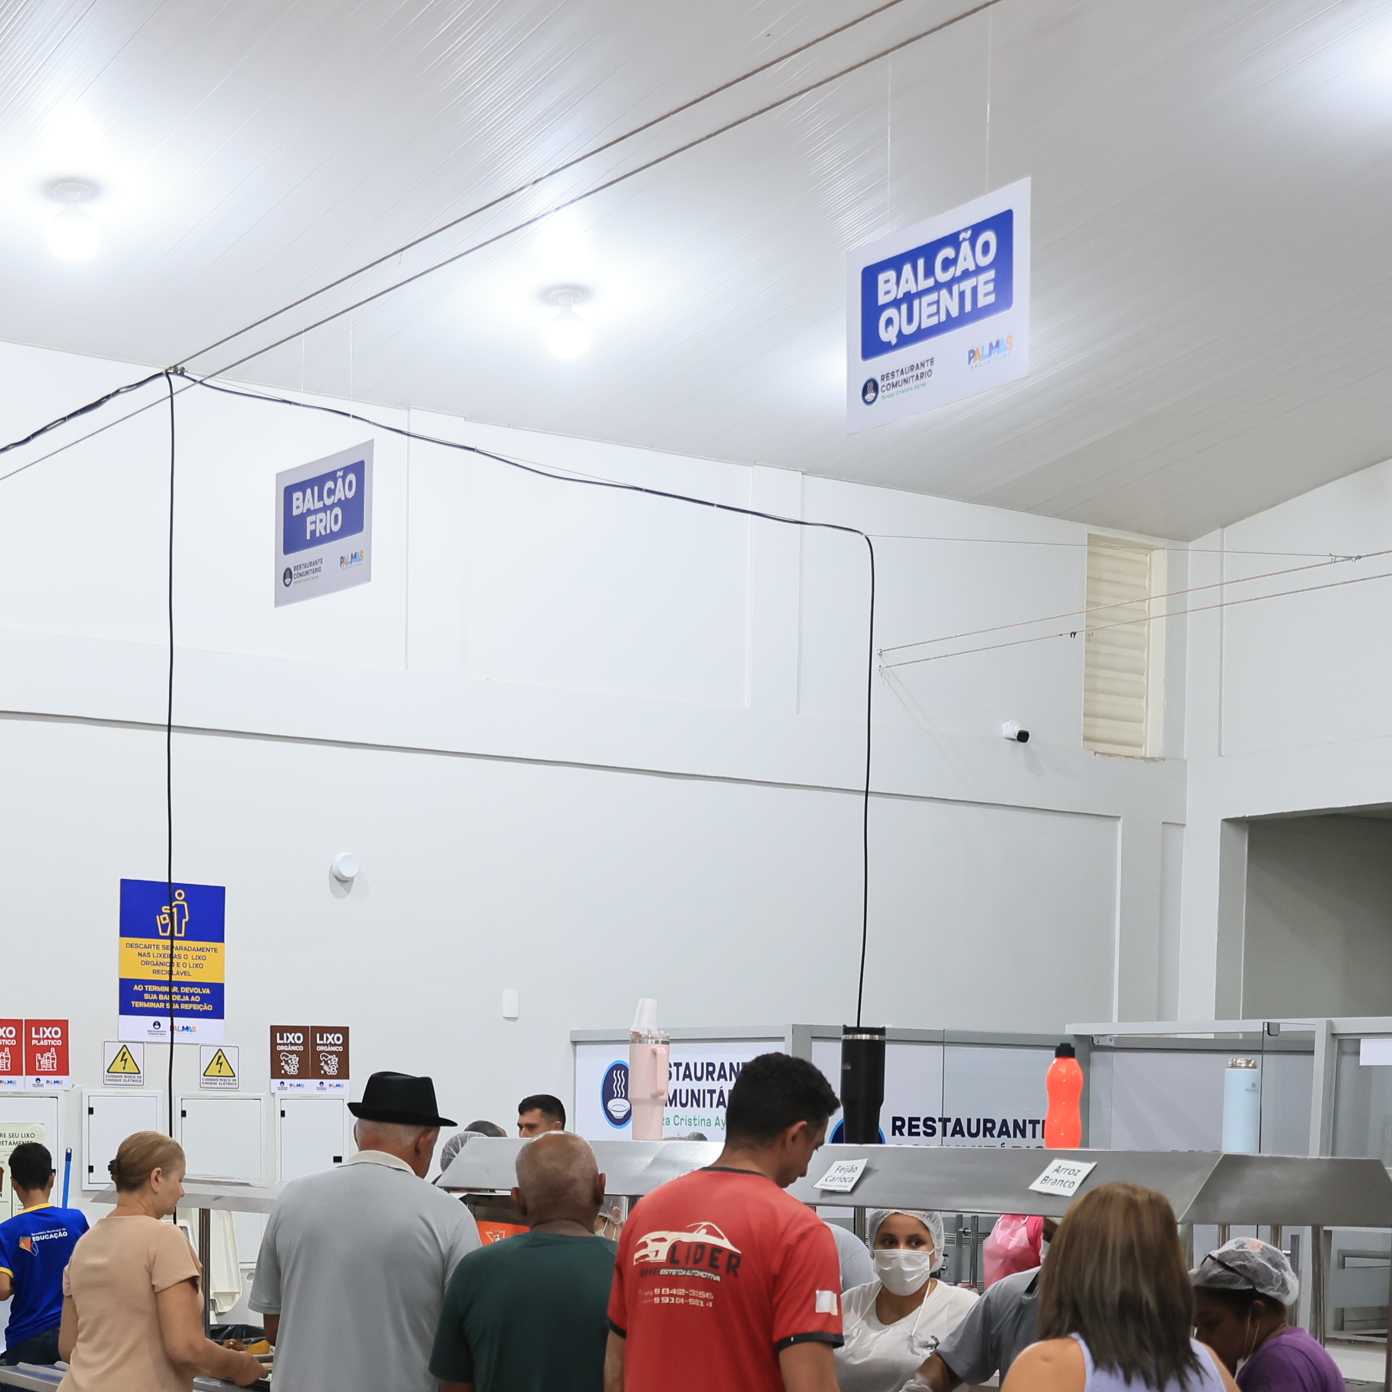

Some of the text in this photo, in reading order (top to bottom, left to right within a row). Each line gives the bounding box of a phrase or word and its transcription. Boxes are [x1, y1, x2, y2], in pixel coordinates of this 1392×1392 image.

[878, 230, 997, 306] BALCÃO
[878, 269, 996, 346] QUENTE
[968, 335, 1014, 366] PALMAS
[880, 357, 935, 383] RESTAURANTE
[880, 369, 933, 393] COMUNITÁRIO
[292, 470, 356, 516] BALCÃO
[306, 507, 342, 540] FRIO
[153, 952, 182, 960] LIXEIAS
[131, 1001, 164, 1009] TERMINAR
[181, 1003, 213, 1012] REFEIÇÃO
[31, 1027, 62, 1038] LIXO
[276, 1032, 304, 1044] LIXO
[316, 1033, 343, 1044] LIXO
[31, 1038, 62, 1046] PLÁSTICO
[668, 1062, 743, 1082] STAURAN
[665, 1086, 729, 1108] MUNITÁ
[673, 1115, 712, 1127] Cristina
[891, 1116, 1046, 1139] RESTAURANT
[834, 1165, 858, 1176] Feijão
[1052, 1165, 1081, 1176] Arroz
[824, 1175, 855, 1183] Carioca
[1040, 1175, 1076, 1188] Branco
[32, 1231, 68, 1242] EDUCAÇÃO
